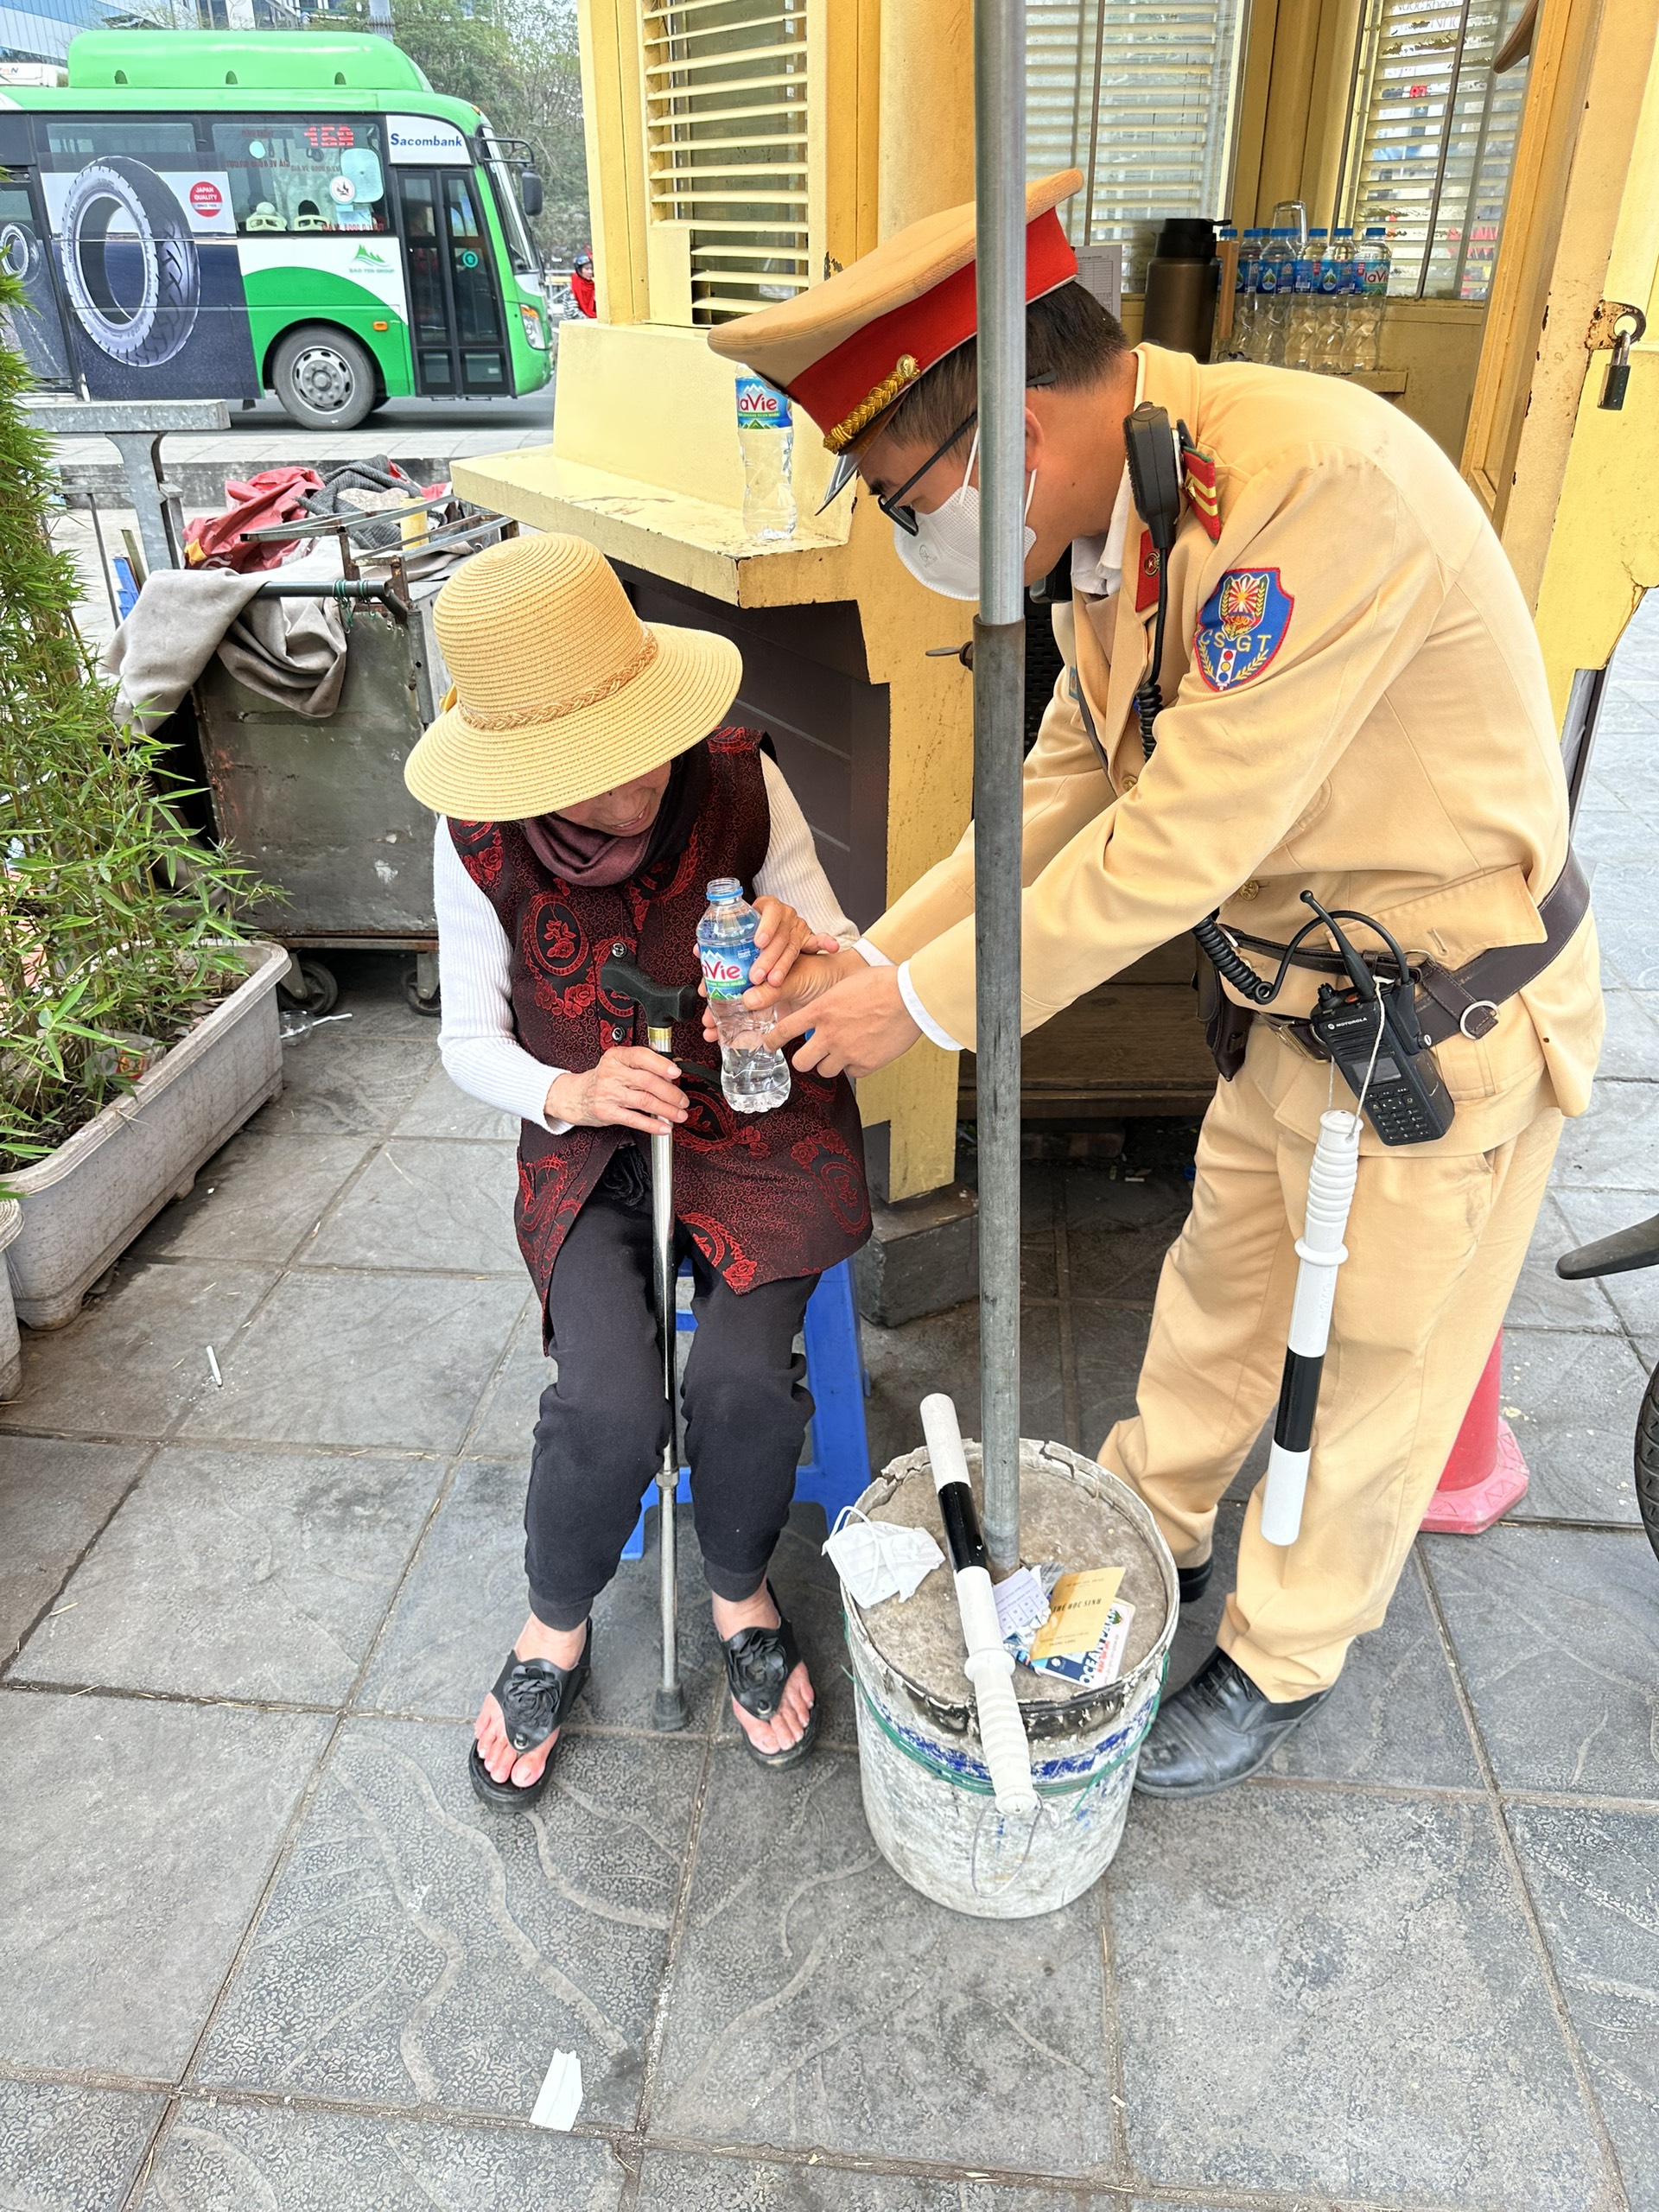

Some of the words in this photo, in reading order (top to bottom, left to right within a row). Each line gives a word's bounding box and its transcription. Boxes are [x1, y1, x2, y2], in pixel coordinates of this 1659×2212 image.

[391, 133, 462, 146] Sacombank
[1336, 1017, 1367, 1027] MOTOROLA
[1078, 1640, 1104, 1686] OCEAN
